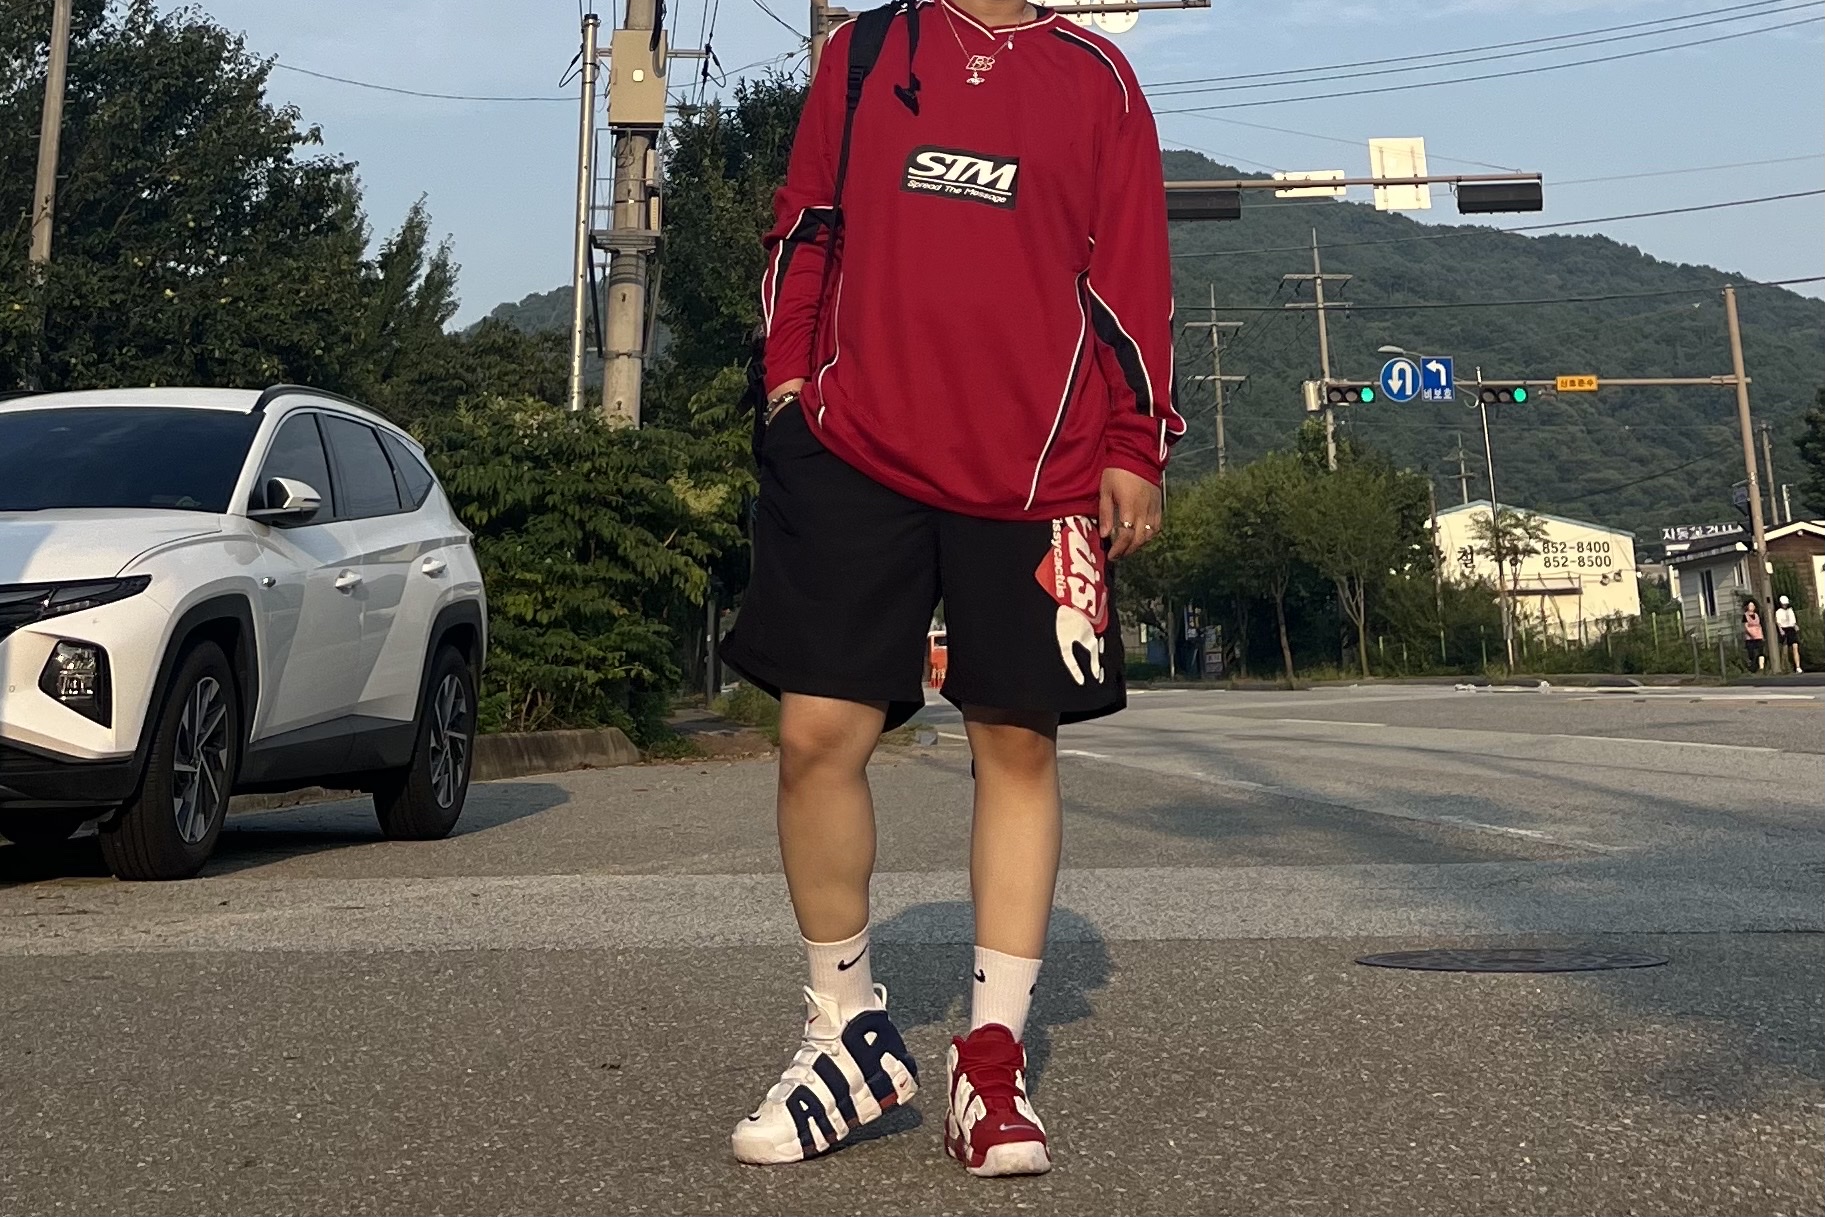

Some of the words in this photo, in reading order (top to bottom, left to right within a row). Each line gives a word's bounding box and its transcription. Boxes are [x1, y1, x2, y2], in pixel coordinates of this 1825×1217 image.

[908, 151, 1018, 191] STM
[907, 180, 943, 191] Spread
[945, 185, 963, 195] The
[964, 188, 1007, 203] Message
[1423, 388, 1453, 401] 비보호
[1542, 541, 1611, 554] 852-8400
[1543, 555, 1612, 568] 852-8500
